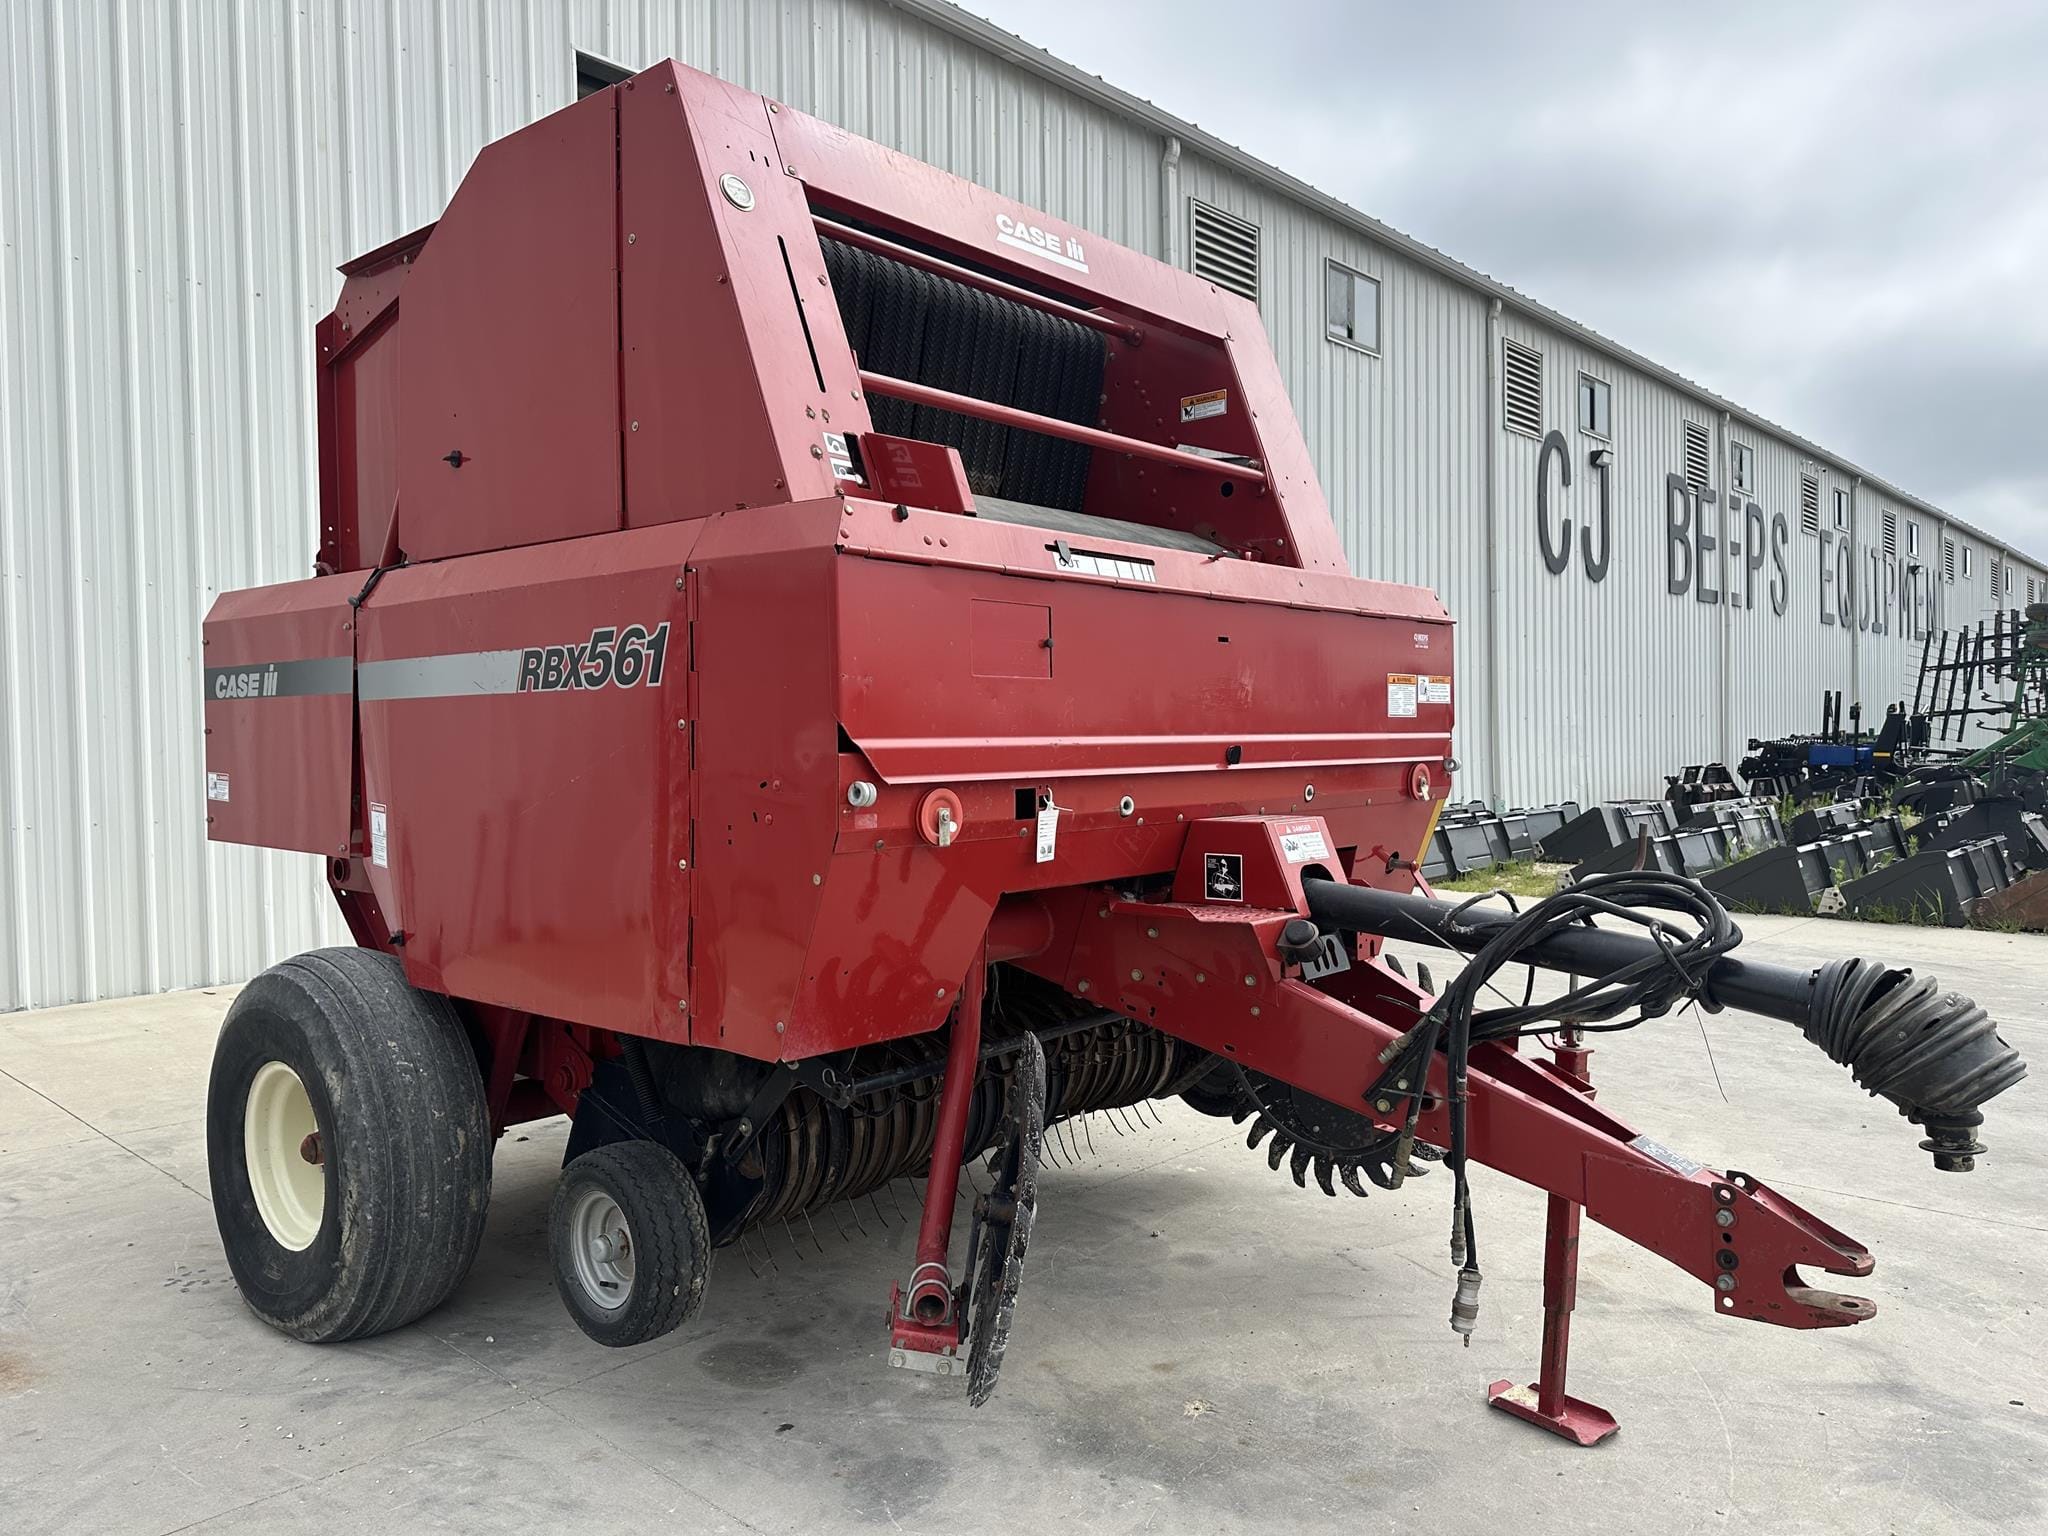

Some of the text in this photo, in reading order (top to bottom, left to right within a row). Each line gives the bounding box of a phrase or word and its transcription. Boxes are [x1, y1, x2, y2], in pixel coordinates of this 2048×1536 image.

[996, 214, 1062, 254] CASE
[1538, 430, 1946, 643] CJ BEEPS EQUIPMEN
[518, 622, 671, 693] RBX561
[215, 673, 260, 699] CASE
